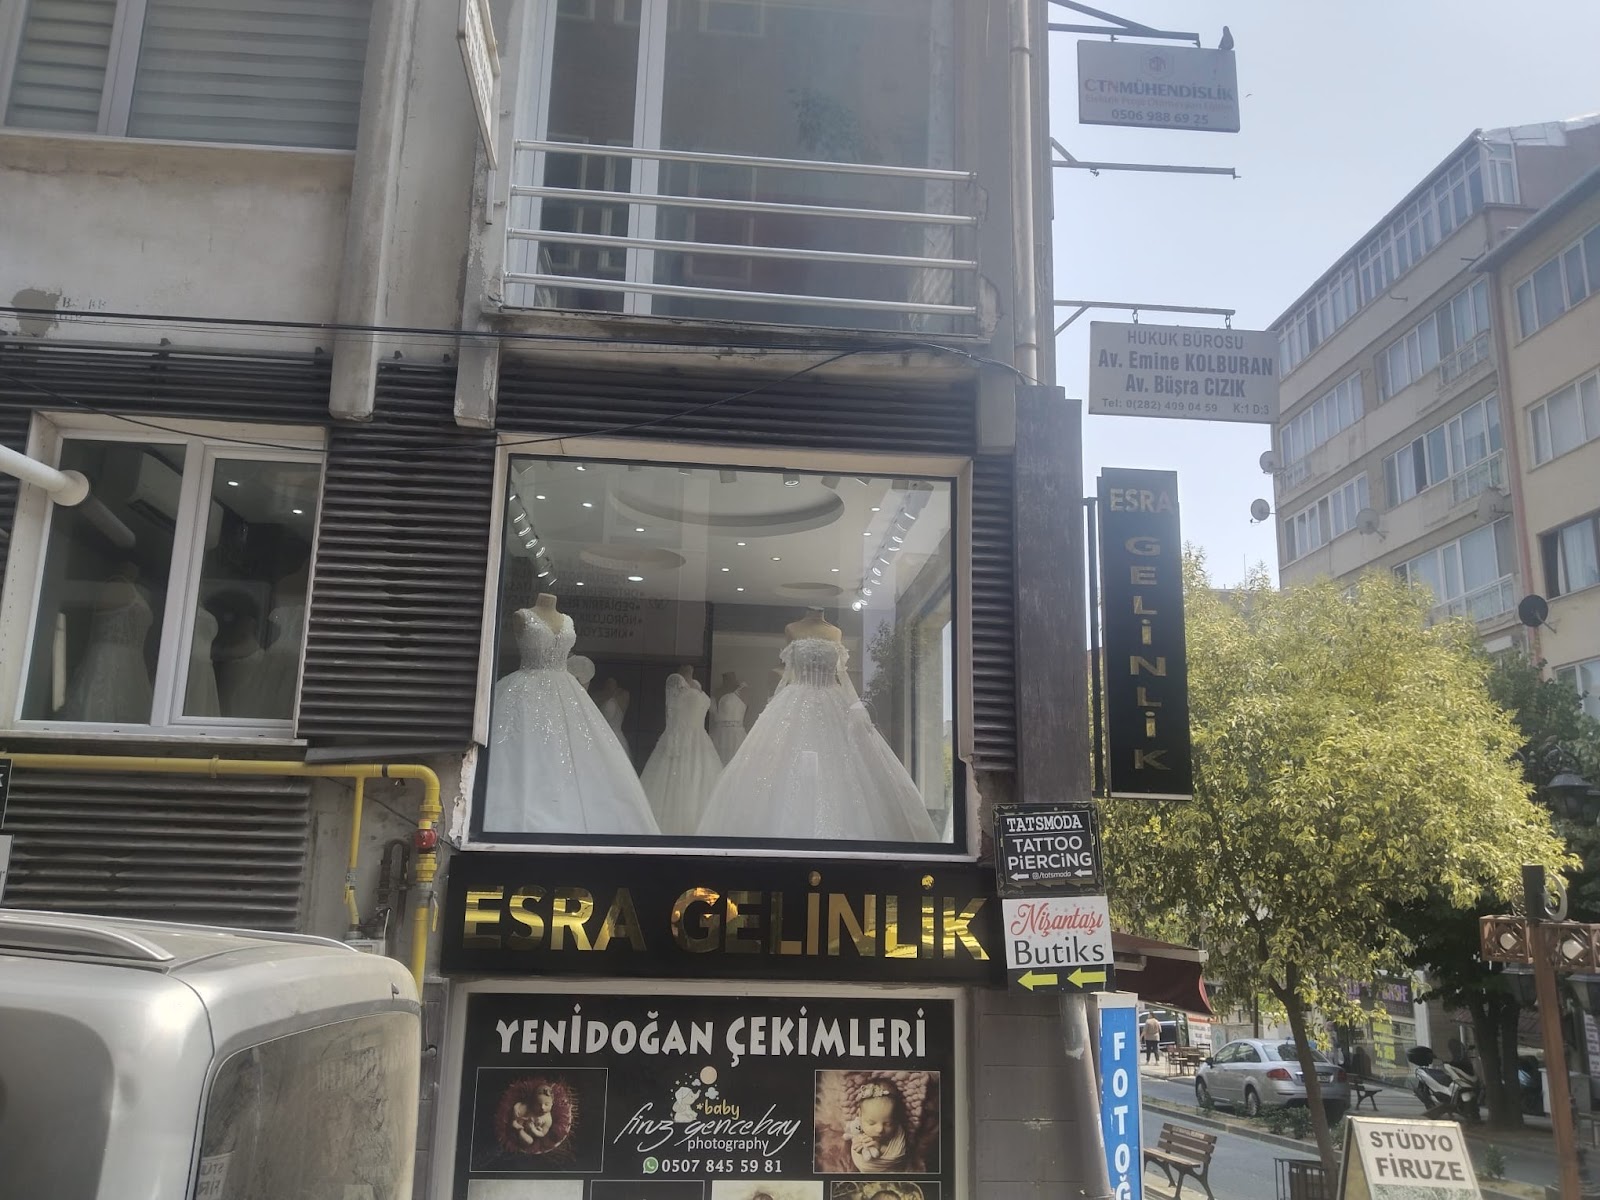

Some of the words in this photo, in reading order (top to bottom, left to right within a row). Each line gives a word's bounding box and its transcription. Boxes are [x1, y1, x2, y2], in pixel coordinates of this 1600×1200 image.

[1111, 109, 1143, 121] 0506
[1147, 112, 1171, 122] 988
[1174, 113, 1189, 123] 69
[1193, 114, 1209, 125] 25
[1127, 330, 1178, 346] HUKUK
[1098, 348, 1123, 368] Av.
[1129, 350, 1179, 370] Emine
[1185, 353, 1273, 376] KOLBURAN
[1125, 374, 1148, 393] Av.
[1154, 375, 1199, 397] Büşra
[1102, 398, 1122, 408] Tel:
[1126, 399, 1161, 411] 0(282)
[1188, 401, 1201, 412] 04
[1205, 403, 1218, 412] 59
[1110, 487, 1176, 514] ESRA
[1124, 536, 1172, 771] GELİNLİK
[1007, 814, 1083, 832] TATSMODA
[1013, 836, 1082, 853] TATTOO
[462, 885, 647, 952] ESRA
[671, 870, 990, 961] GELİNLİK
[1010, 902, 1103, 937] Nişantaşı
[1014, 936, 1104, 966] Butiks
[496, 1003, 714, 1055] YENİDOĞAN
[726, 1005, 927, 1067] ÇEKİMLERİ
[704, 1099, 740, 1120] baby
[674, 1103, 801, 1157] gencebay
[1370, 1128, 1453, 1152] STÜDYO
[687, 1137, 769, 1152] photography
[661, 1159, 700, 1173] 0507
[705, 1159, 734, 1173] 845
[740, 1159, 759, 1173] 59
[764, 1160, 782, 1173] 81
[1375, 1152, 1466, 1181] FİRUZE
